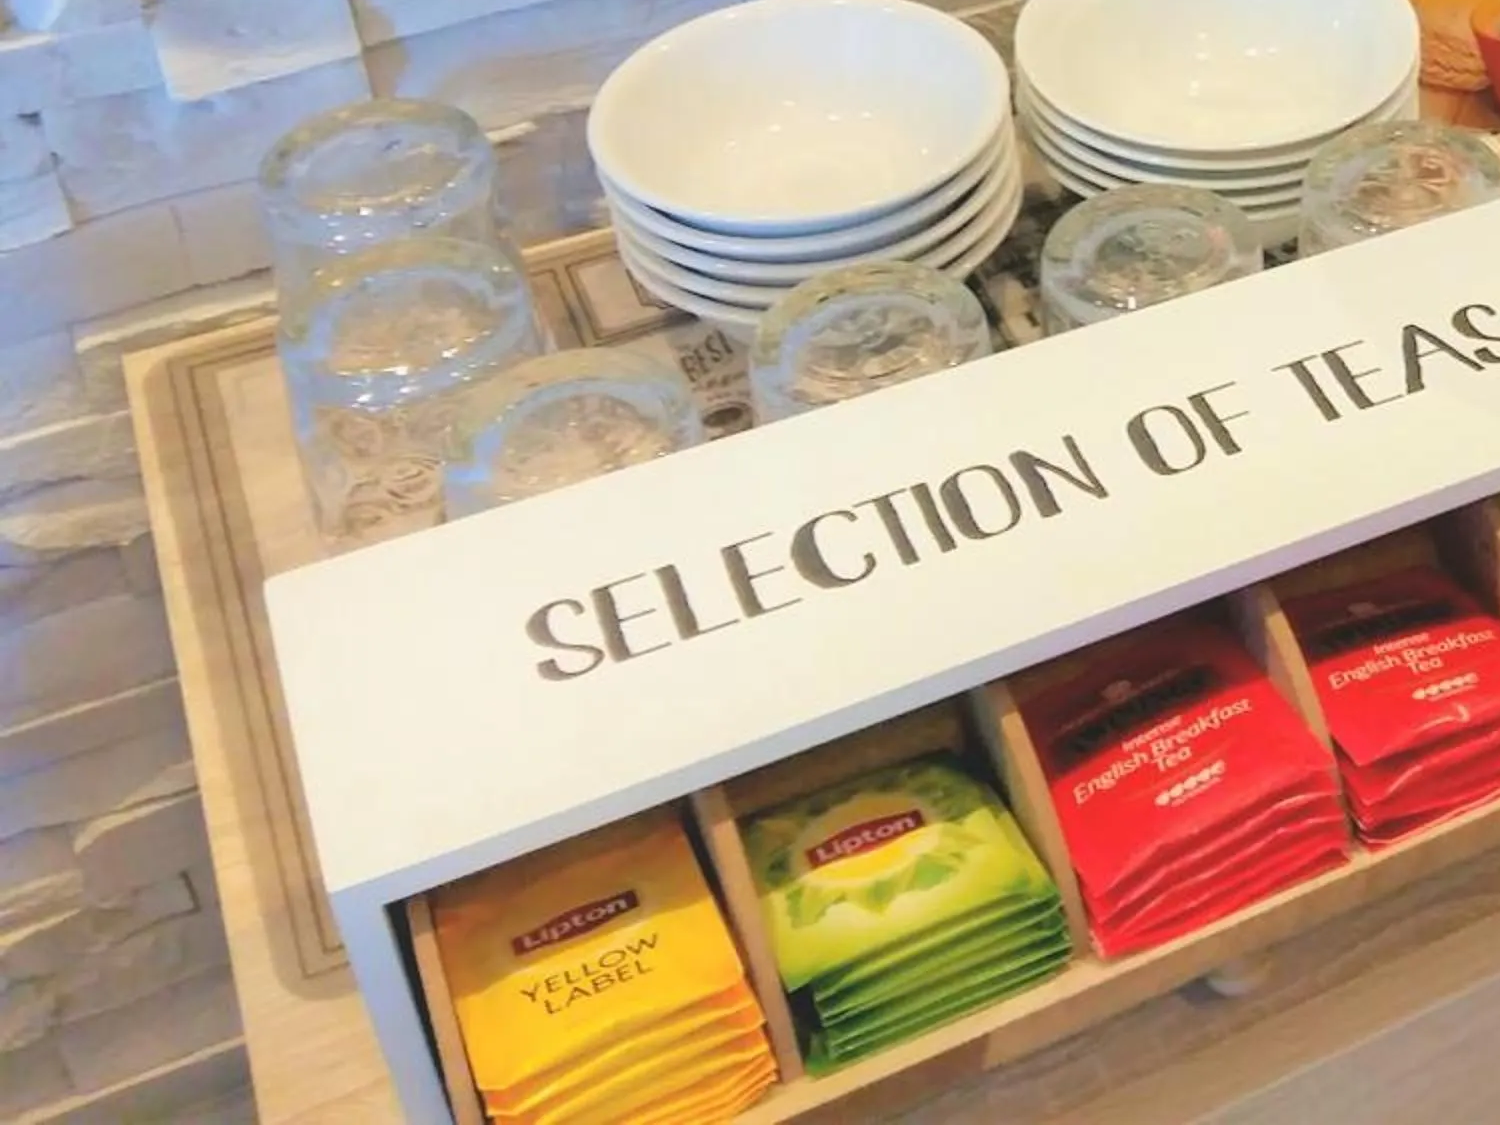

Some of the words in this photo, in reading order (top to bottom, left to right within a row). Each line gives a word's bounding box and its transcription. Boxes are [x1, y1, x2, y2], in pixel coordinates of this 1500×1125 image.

[525, 434, 1110, 682] SELECTION
[1126, 381, 1250, 476] OF
[1327, 651, 1401, 691] English
[1402, 628, 1497, 663] Breakfast
[1407, 656, 1444, 675] Tea
[1072, 750, 1150, 806] English
[1150, 697, 1254, 758] Breakfast
[1152, 744, 1193, 772] Tea
[815, 816, 917, 863] Lipton
[522, 898, 629, 950] Lipton
[519, 932, 659, 1003] YELLOW
[543, 959, 653, 1015] LABEL
